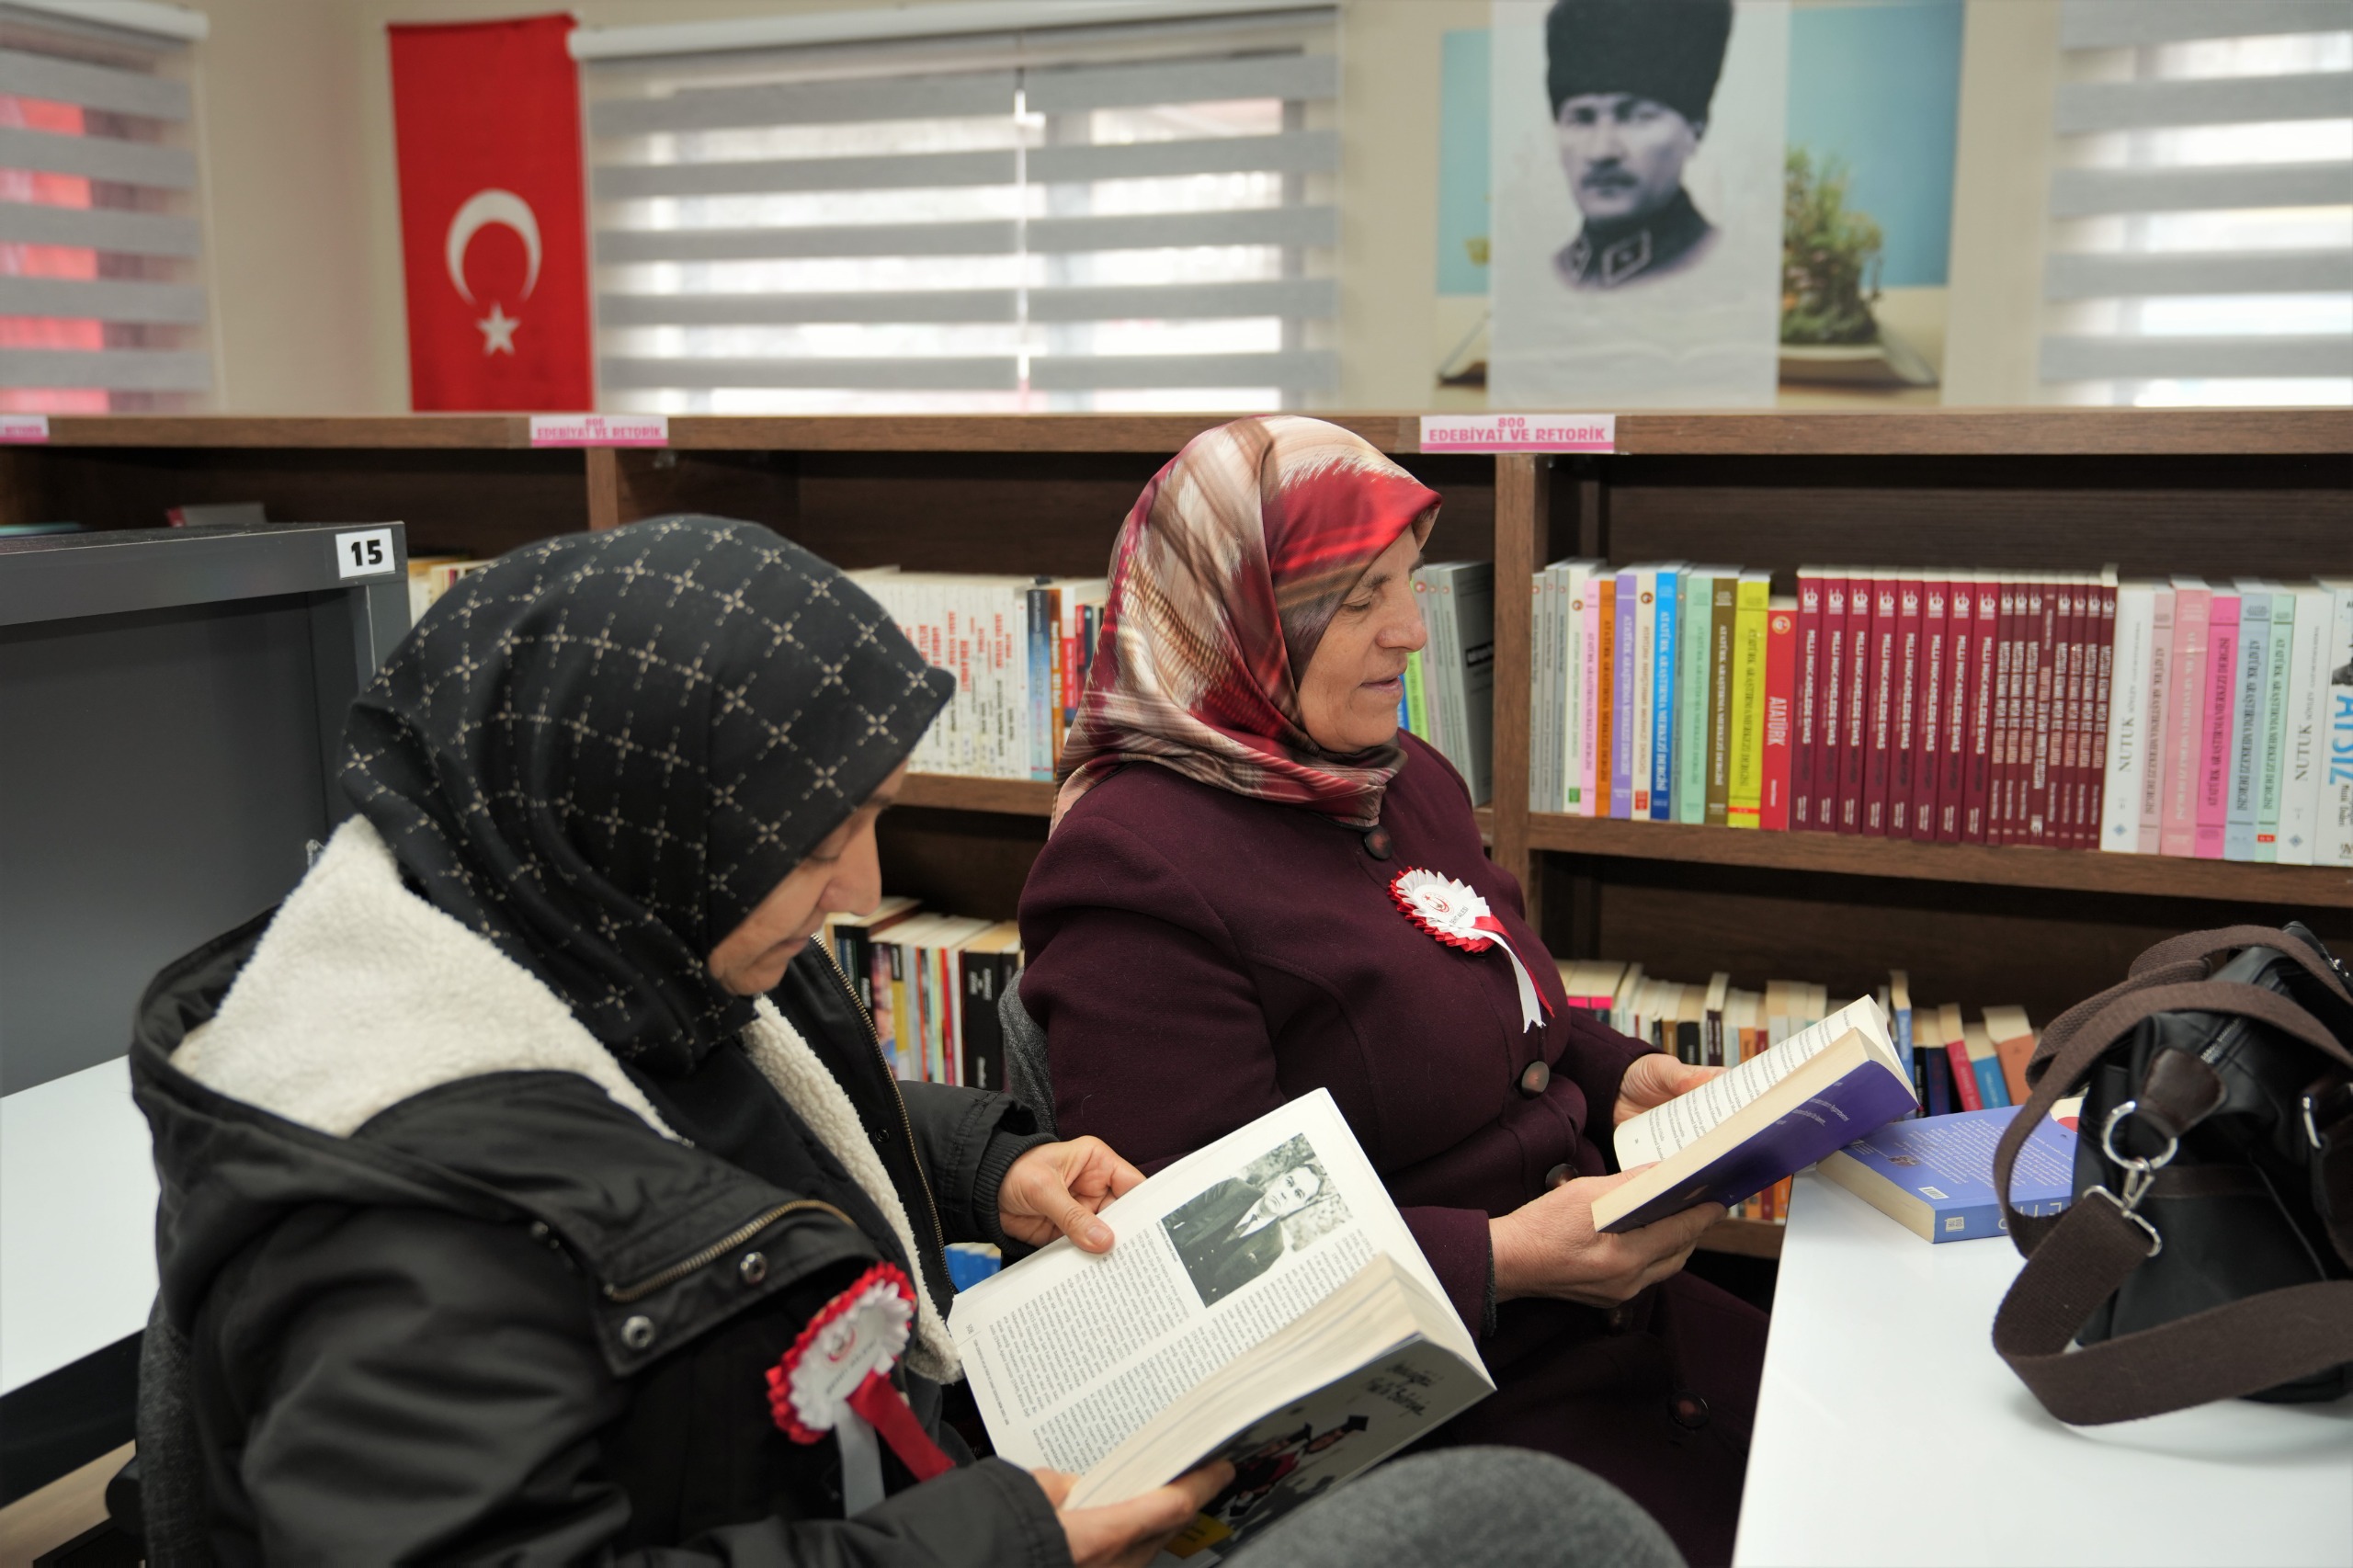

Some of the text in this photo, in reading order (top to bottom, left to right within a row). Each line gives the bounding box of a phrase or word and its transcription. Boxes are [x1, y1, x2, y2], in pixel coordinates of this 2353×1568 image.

[537, 426, 591, 439] EDEBİYAT
[595, 426, 608, 439] VE
[1428, 426, 1606, 442] EDEBİYAT VE RETORİK
[1498, 417, 1526, 428] 800
[351, 539, 383, 567] 15
[1767, 696, 1788, 745] ATATÜRK
[2117, 715, 2135, 772] NUTUK
[2294, 722, 2313, 781] NUTUK
